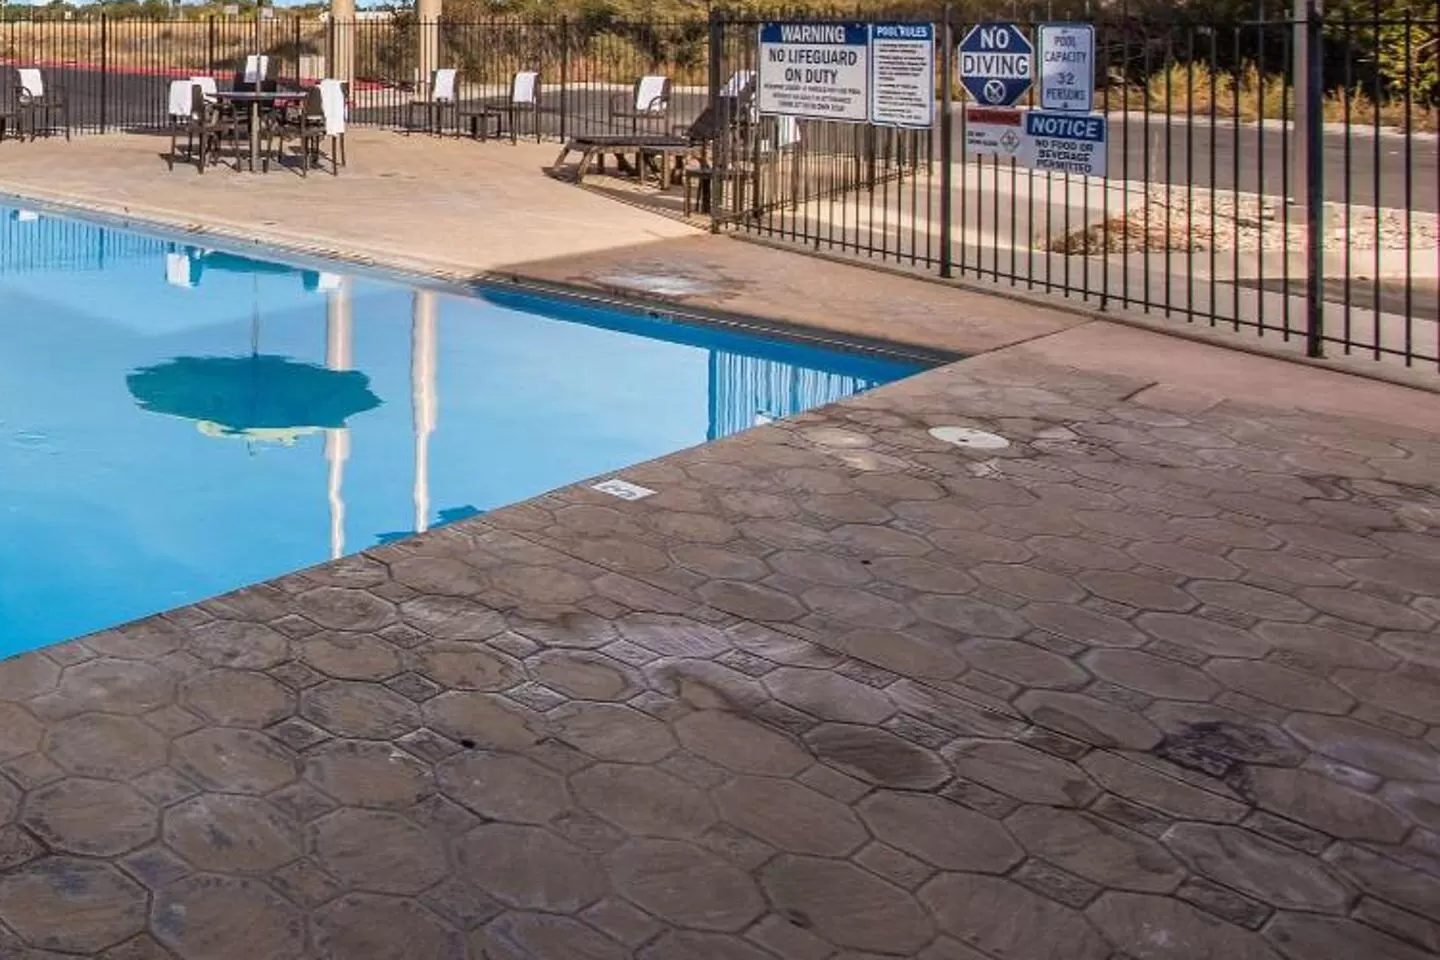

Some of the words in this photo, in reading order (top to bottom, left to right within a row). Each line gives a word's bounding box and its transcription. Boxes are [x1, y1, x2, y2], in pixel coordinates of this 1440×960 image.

[781, 24, 846, 43] WARNING
[900, 26, 928, 38] RULES
[980, 27, 1009, 49] NO
[769, 48, 785, 62] NO
[788, 49, 857, 66] LIFEGUARD
[963, 55, 1028, 75] DIVING
[1044, 51, 1086, 63] CAPACITY
[785, 68, 801, 82] ON
[806, 68, 838, 84] DUTY
[1032, 117, 1099, 137] NOTICE
[1035, 139, 1048, 148] NO
[1052, 140, 1077, 150] FOOD
[1080, 142, 1093, 152] OR
[1039, 149, 1090, 161] BEVERAGE
[1036, 159, 1092, 173] PERMITTED
